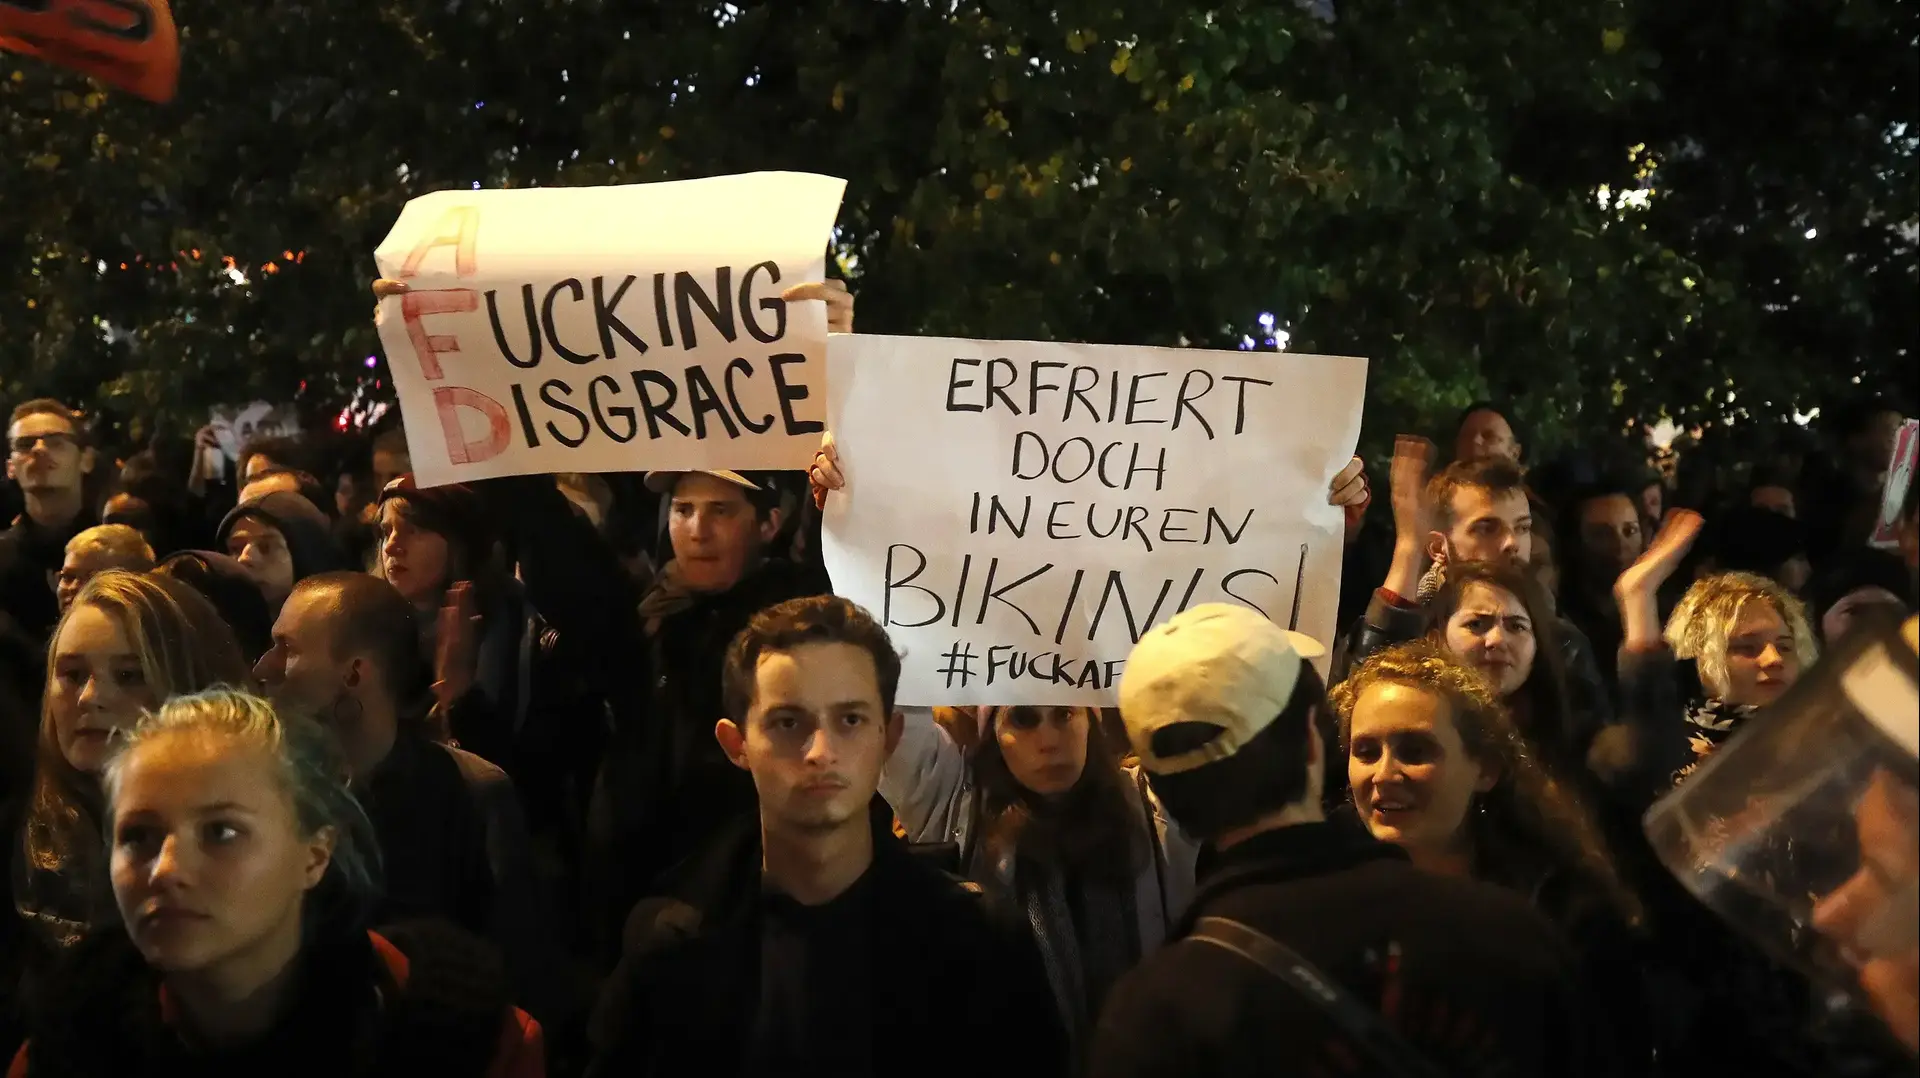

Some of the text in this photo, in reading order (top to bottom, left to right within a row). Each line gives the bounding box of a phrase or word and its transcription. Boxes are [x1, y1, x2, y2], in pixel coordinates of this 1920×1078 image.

[402, 206, 480, 278] A
[402, 260, 787, 381] FUCKING
[432, 353, 825, 466] DISGRACE
[946, 357, 1274, 440] ERFRIERT
[1012, 430, 1166, 491] DOCH
[969, 491, 1255, 552] IN EUREN
[936, 640, 1125, 690] #FUCKAF
